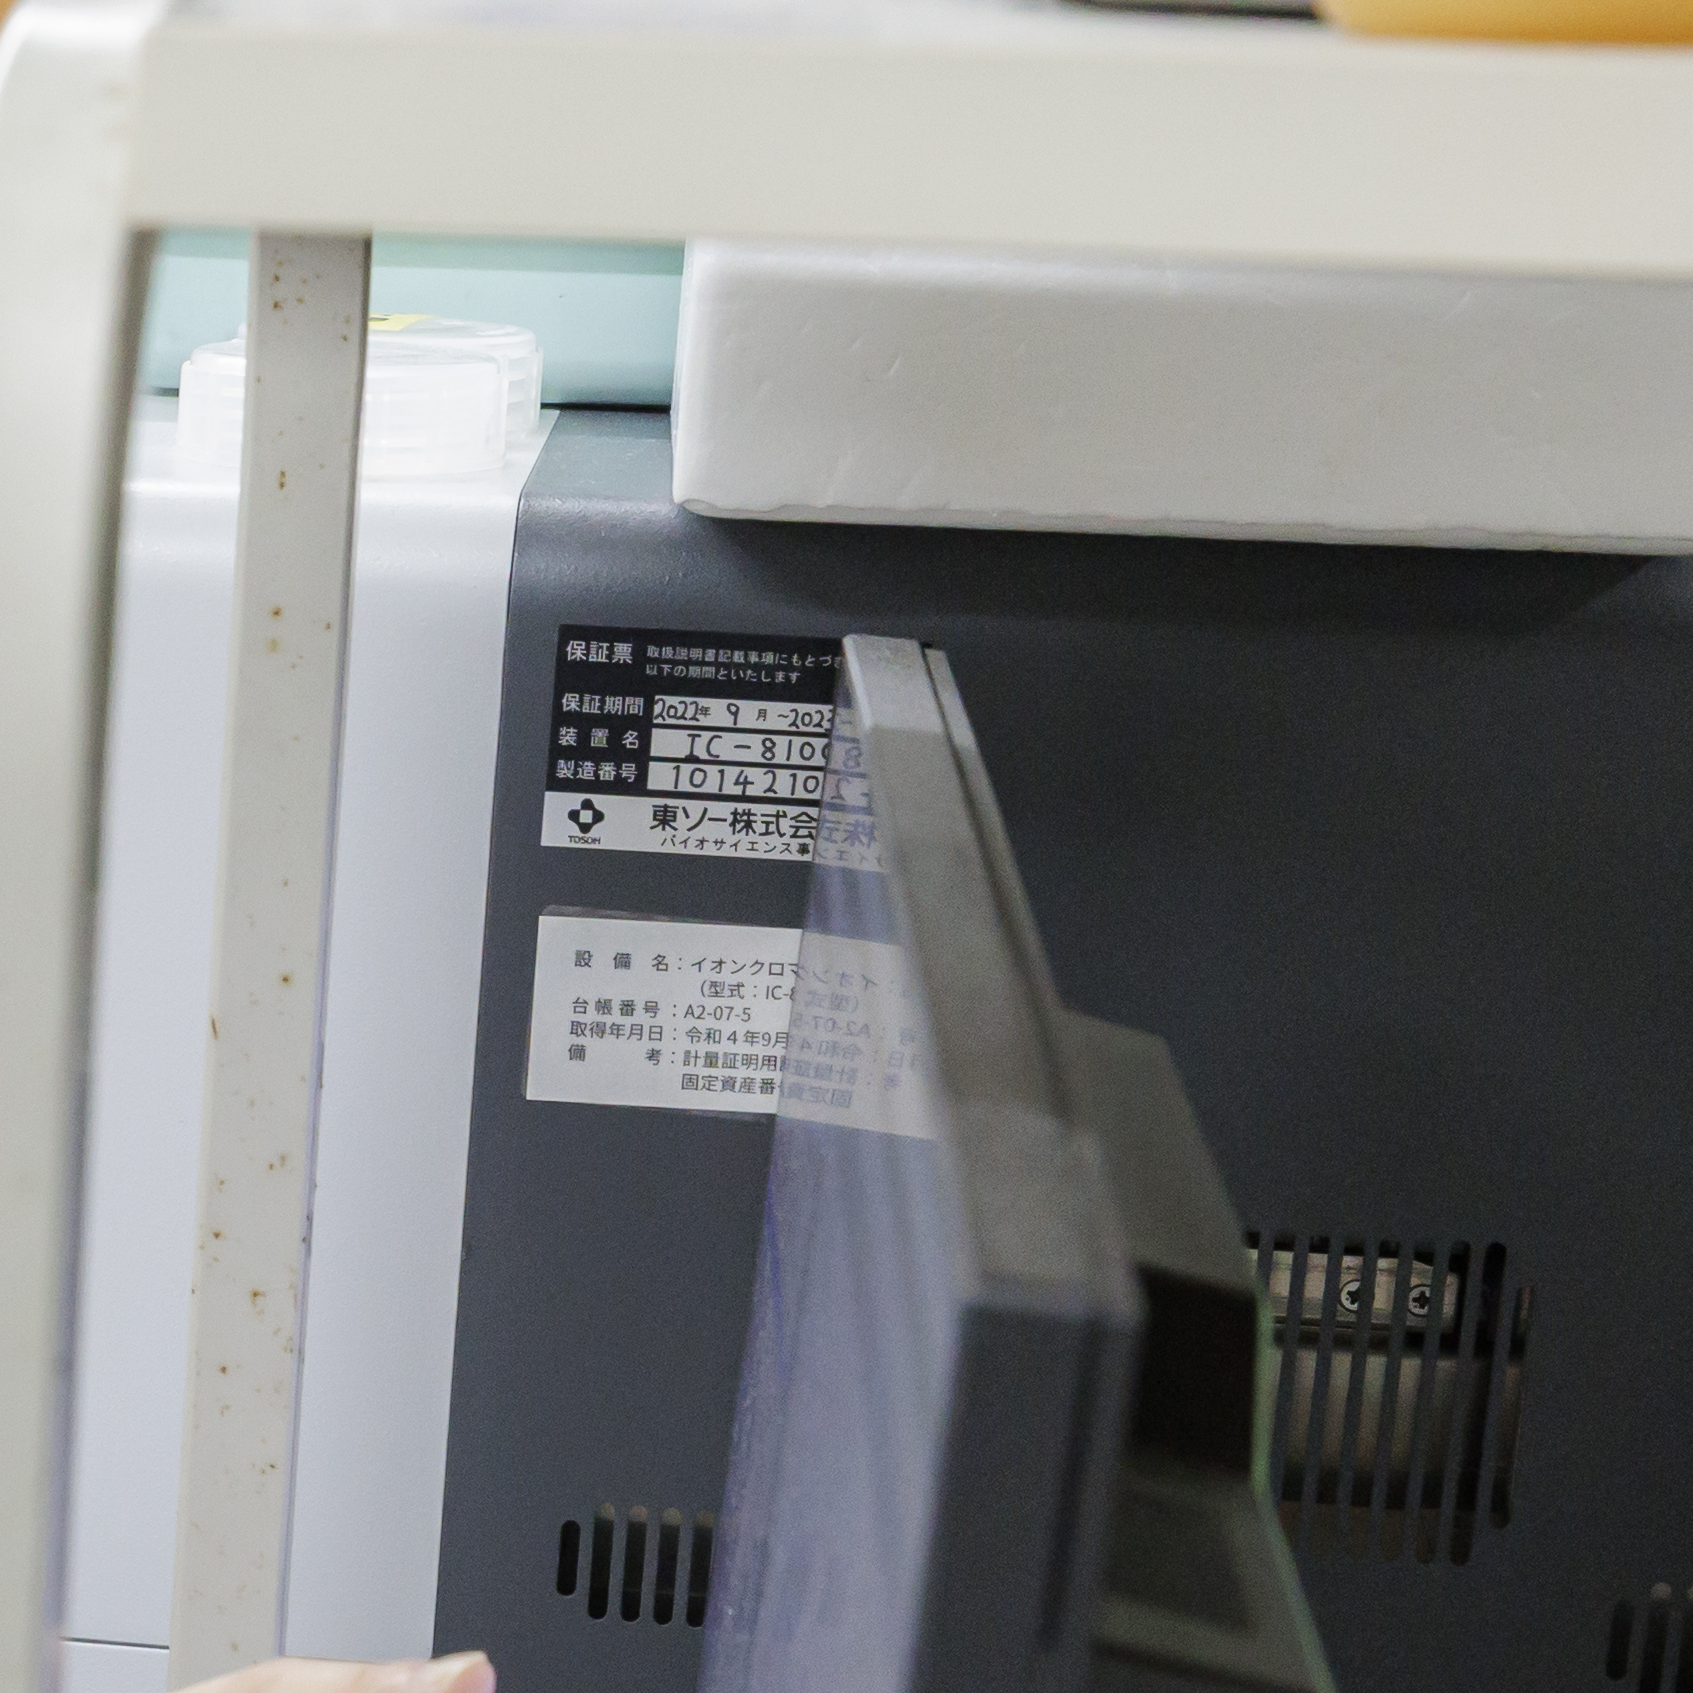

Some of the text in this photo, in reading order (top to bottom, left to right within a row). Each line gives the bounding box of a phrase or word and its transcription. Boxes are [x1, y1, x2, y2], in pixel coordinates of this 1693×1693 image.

[566, 640, 633, 664] 保証票
[561, 693, 645, 716] 保証期間
[555, 759, 638, 783] 製造番号
[568, 835, 601, 845] TOSOH
[681, 1073, 780, 1095] 固定資産番
